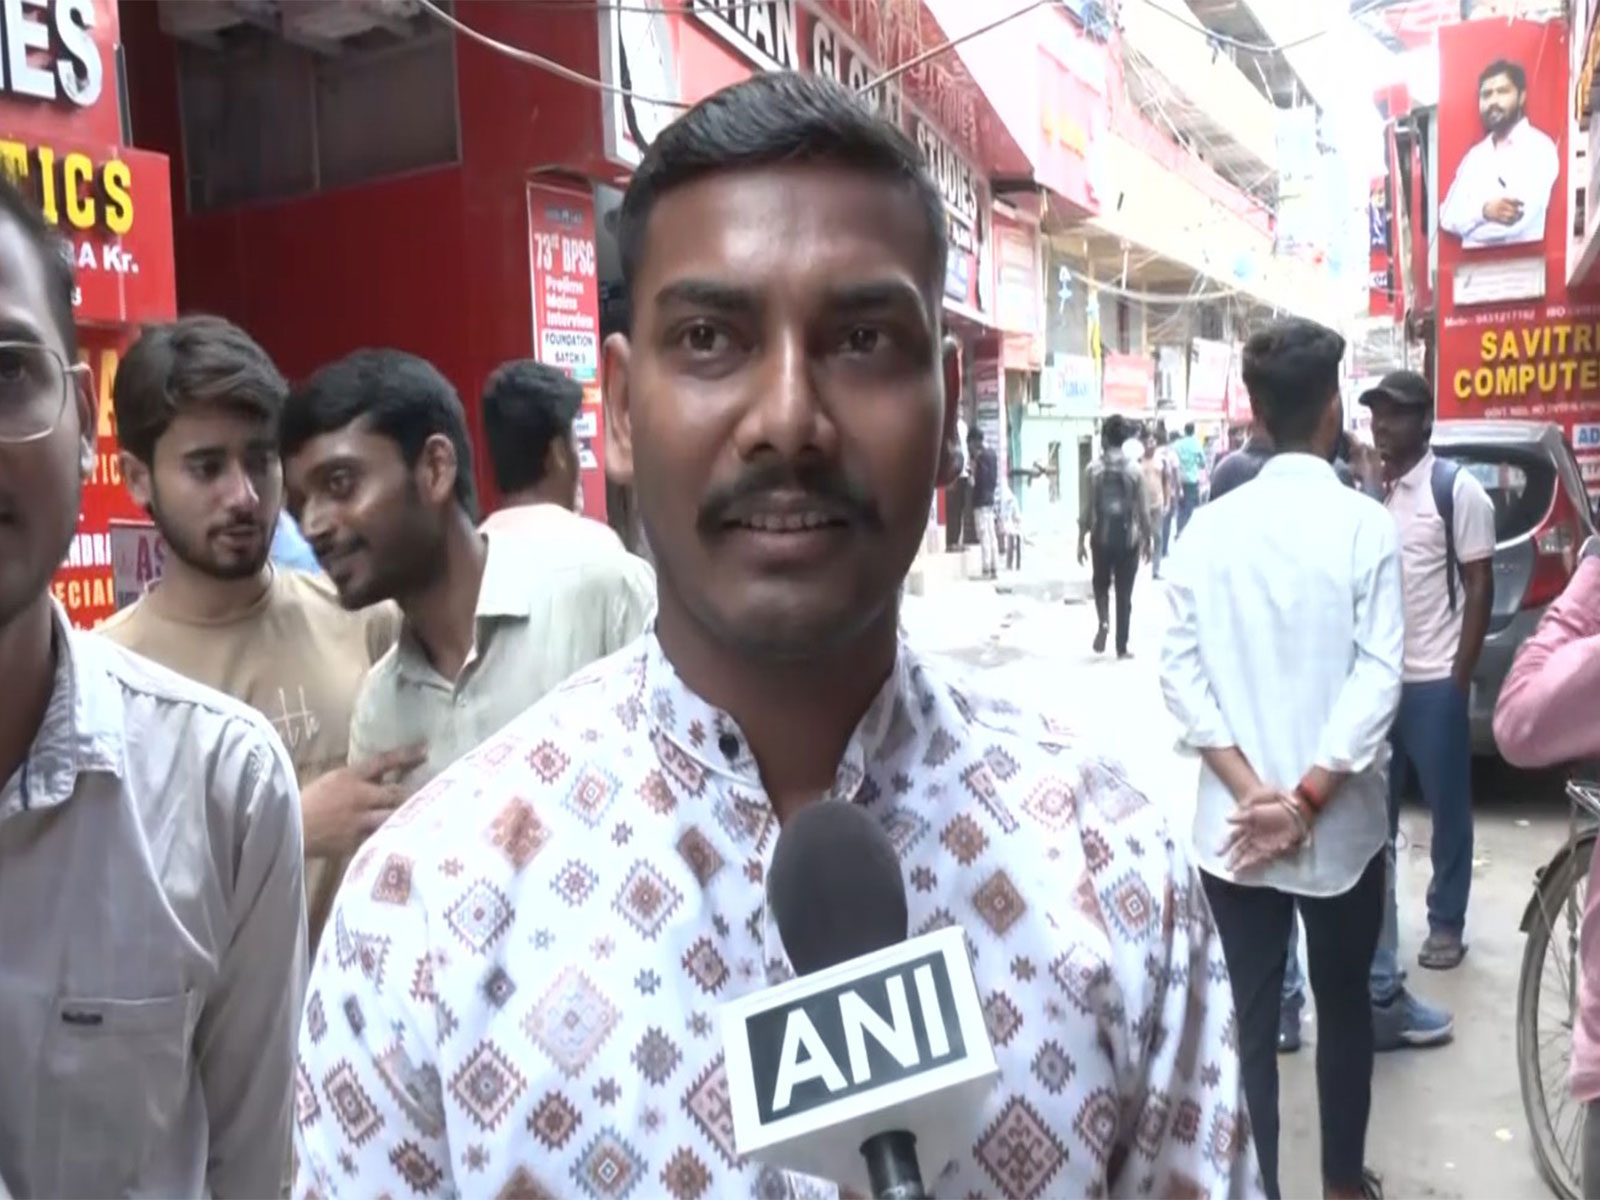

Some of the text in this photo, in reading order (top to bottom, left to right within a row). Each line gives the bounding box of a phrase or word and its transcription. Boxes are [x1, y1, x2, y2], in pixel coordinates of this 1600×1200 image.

[0, 0, 103, 106] ES
[916, 119, 978, 222] STUDIES
[103, 244, 139, 273] Kr.
[562, 236, 596, 277] BPSC
[545, 332, 593, 346] FOUNDATION
[1453, 362, 1600, 399] COMPUTE
[771, 963, 950, 1112] ANI
